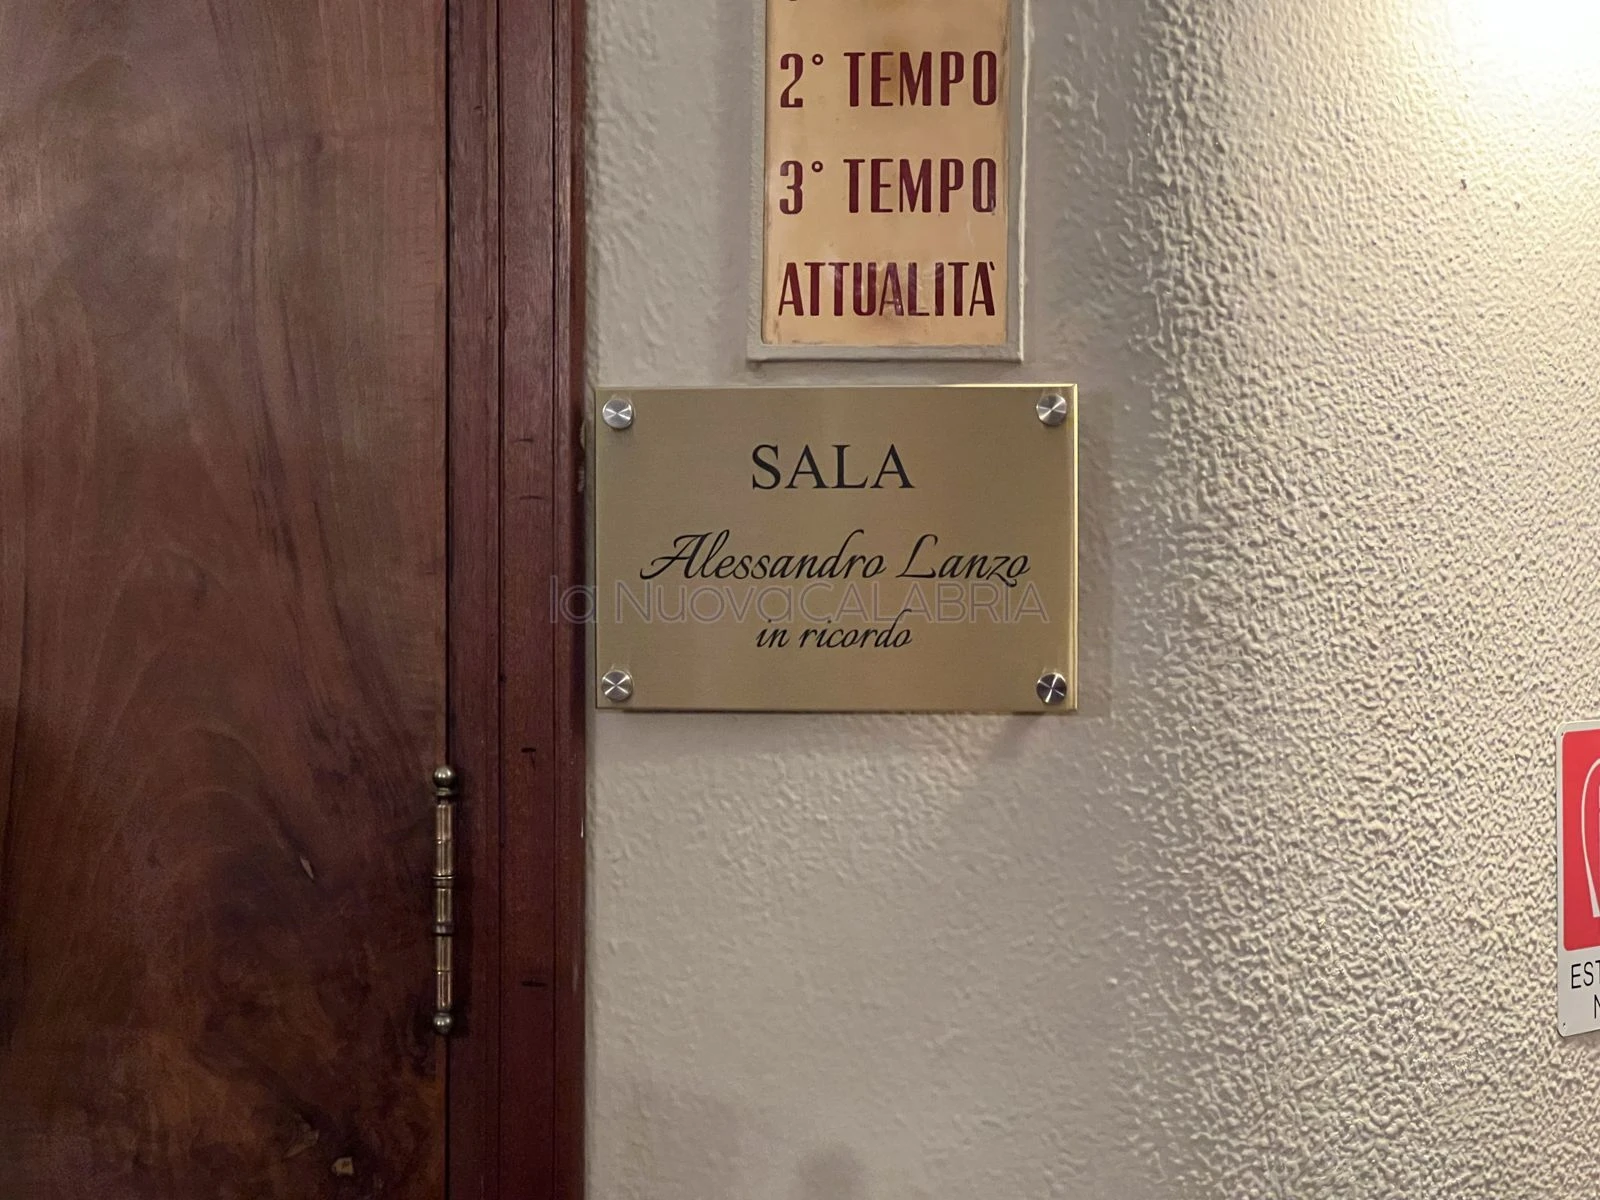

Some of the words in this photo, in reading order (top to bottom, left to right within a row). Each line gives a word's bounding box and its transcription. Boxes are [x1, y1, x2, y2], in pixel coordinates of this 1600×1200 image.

[780, 53, 824, 108] 2°
[843, 51, 998, 107] TEMPO
[779, 160, 824, 215] 3°
[843, 158, 997, 213] TEMPO
[778, 261, 996, 317] ATTUALITÀ
[751, 443, 916, 490] SALA
[639, 529, 888, 581] Alessandro
[896, 533, 1032, 588] Lanzo
[755, 618, 791, 649] in
[798, 608, 913, 649] ricordo
